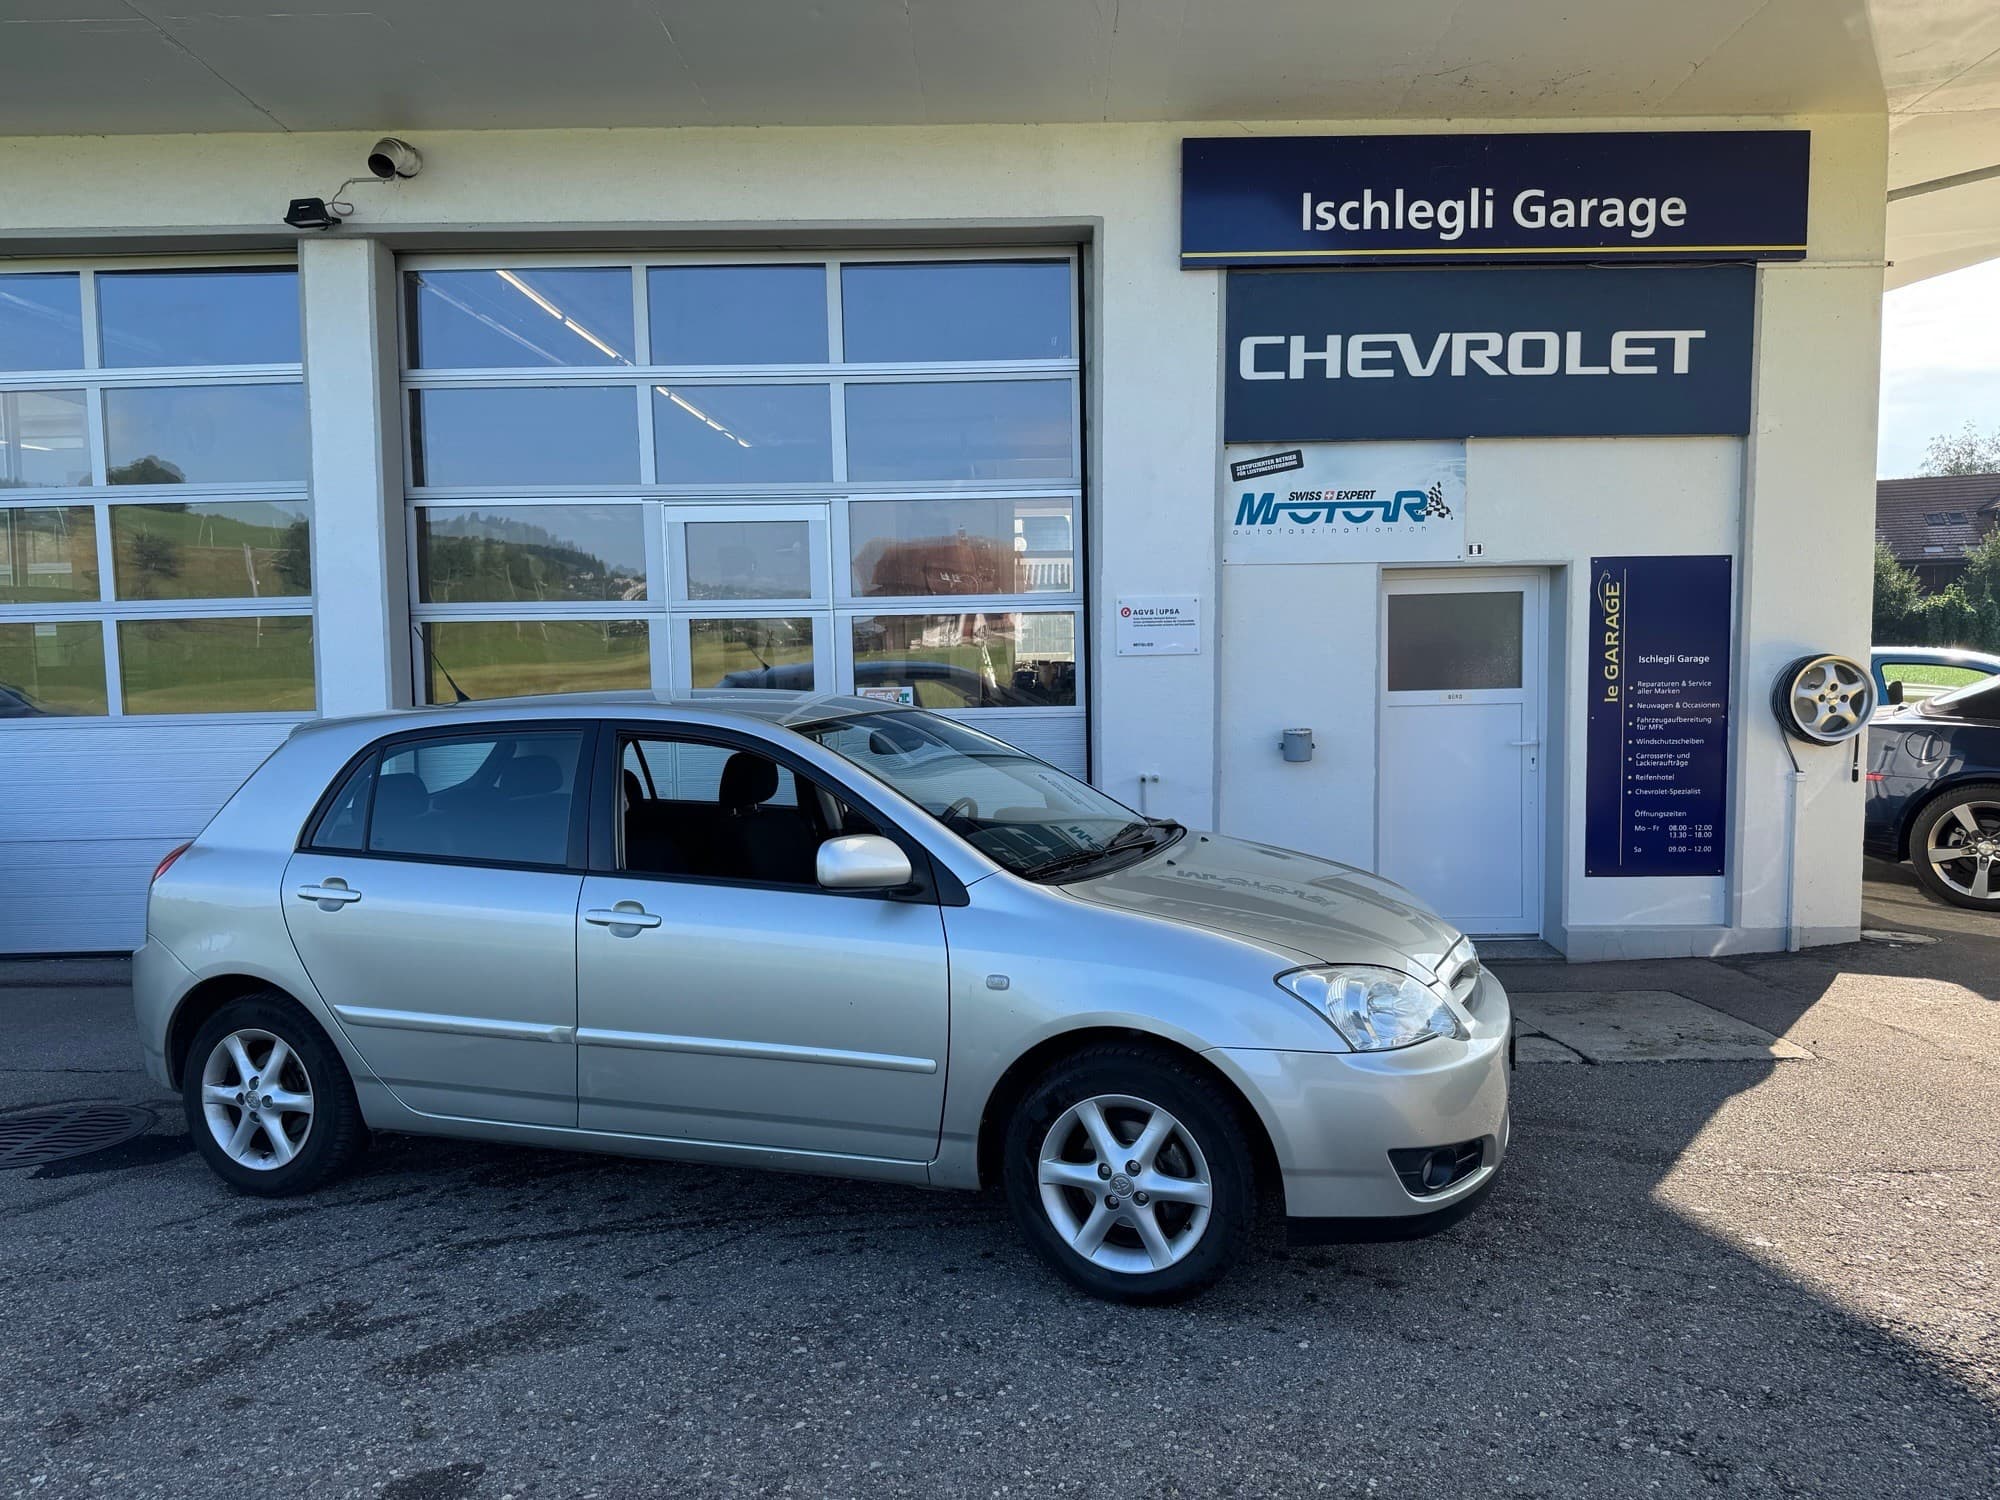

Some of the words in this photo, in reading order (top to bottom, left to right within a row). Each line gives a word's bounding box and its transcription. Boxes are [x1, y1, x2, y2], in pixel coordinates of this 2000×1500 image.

[1302, 188, 1495, 240] Ischlegli
[1513, 189, 1688, 238] Garage
[1239, 330, 1706, 380] CHEVROLET
[1288, 491, 1322, 501] SWISS
[1336, 489, 1377, 500] EXPERT
[1604, 582, 1620, 680] GARAGE
[1638, 655, 1675, 665] Ischlegli
[1677, 655, 1710, 665] Garage
[1637, 680, 1680, 688] Reparaturen
[1604, 685, 1619, 702] le
[1637, 702, 1673, 710] Neuwagen
[1636, 716, 1712, 725] Fahrzeugaufbereitung
[1635, 759, 1689, 767] Lackieraufträge
[1635, 788, 1701, 796] Chevrolet-Spezialist
[1634, 809, 1687, 818] Öffnungszeiten
